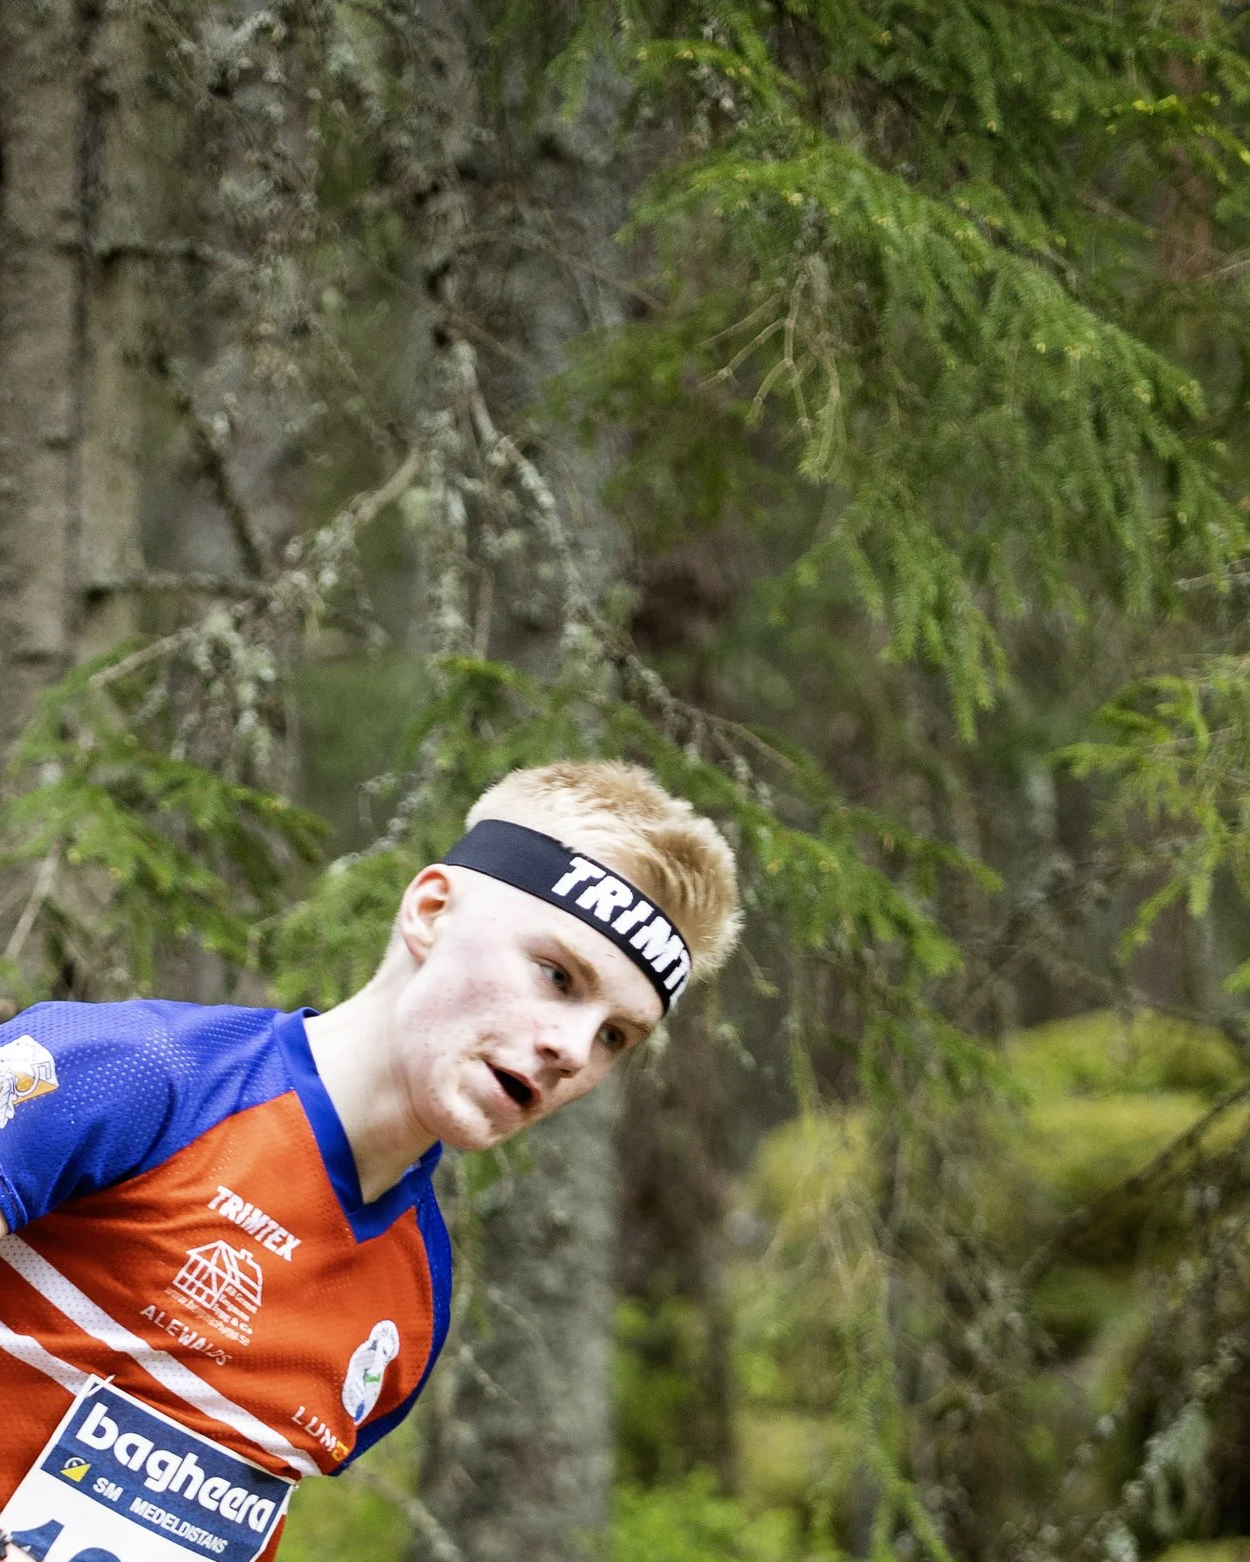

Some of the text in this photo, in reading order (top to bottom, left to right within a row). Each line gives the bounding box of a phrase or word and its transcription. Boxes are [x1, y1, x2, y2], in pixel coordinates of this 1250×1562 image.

[551, 856, 692, 1000] TRIMT
[207, 1185, 302, 1262] TRIMTEX
[140, 1304, 234, 1367] ALEWALDS
[76, 1401, 277, 1533] bagheera
[92, 1477, 229, 1554] SM MEDELDISTANS
